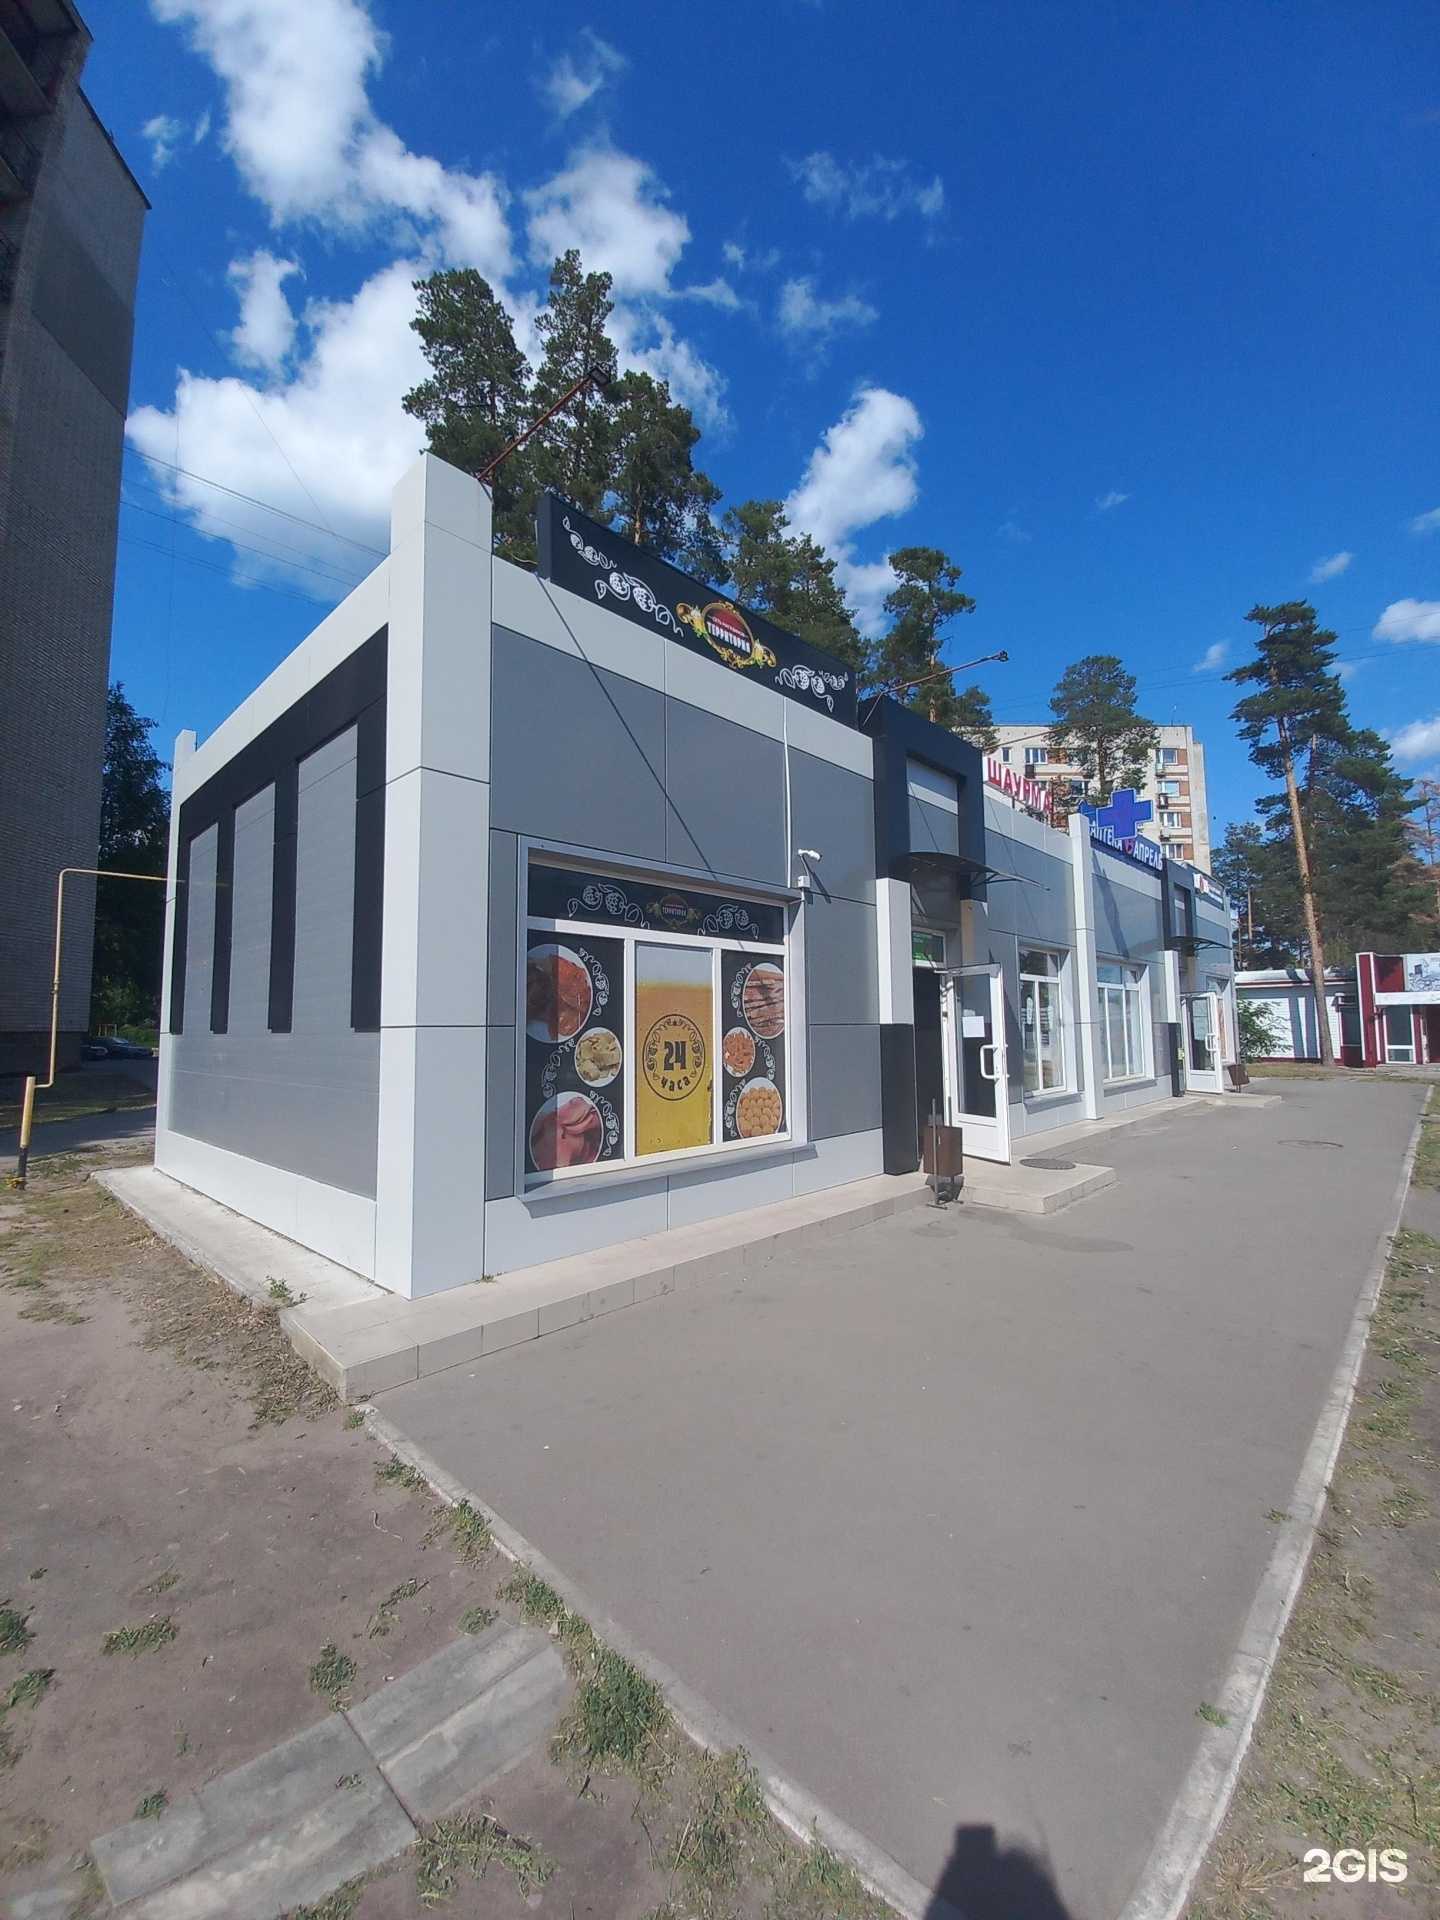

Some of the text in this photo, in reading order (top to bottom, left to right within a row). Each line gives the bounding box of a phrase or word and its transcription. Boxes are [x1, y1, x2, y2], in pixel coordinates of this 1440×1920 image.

[988, 757, 1054, 815] ШАУРМА
[1133, 841, 1163, 870] АПРЕЛЬ
[663, 1040, 687, 1071] 24
